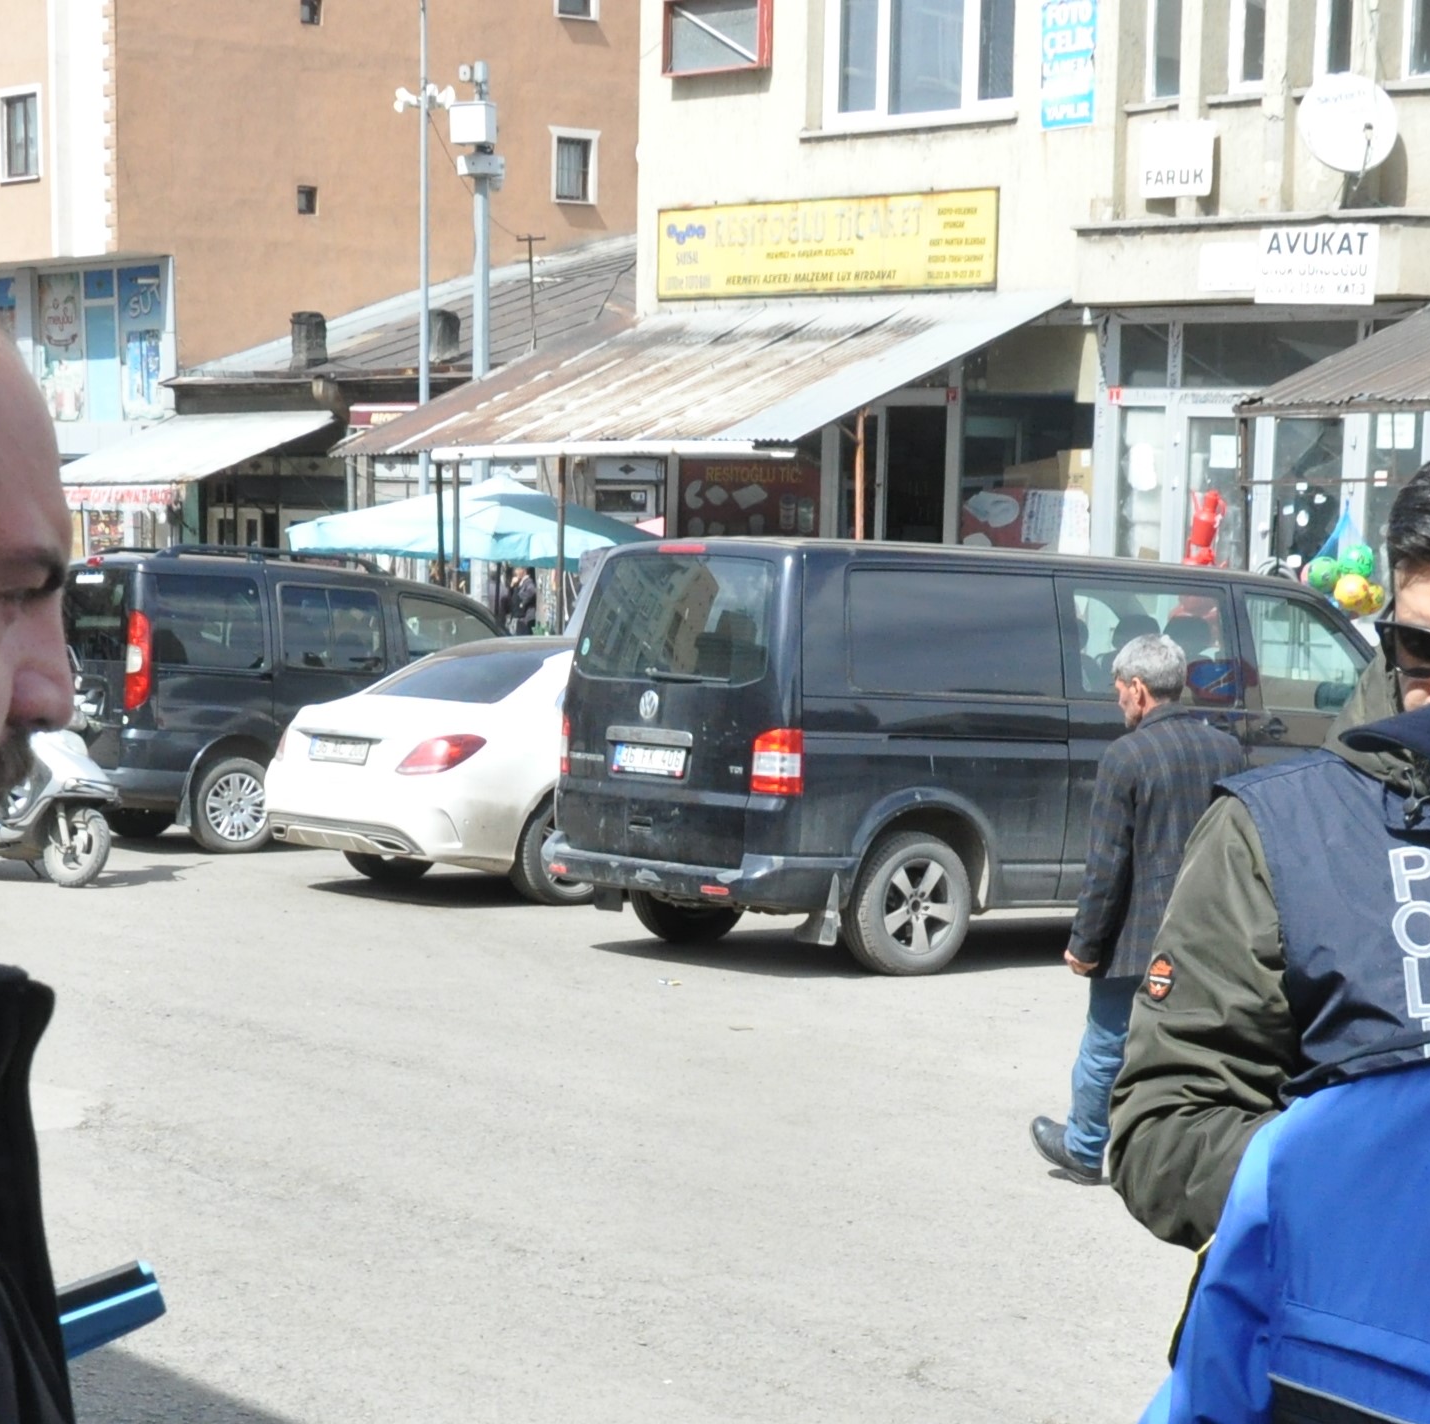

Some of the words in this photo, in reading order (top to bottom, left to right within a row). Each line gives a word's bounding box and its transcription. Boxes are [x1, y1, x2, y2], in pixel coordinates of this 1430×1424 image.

[1145, 168, 1204, 186] FARUK
[1266, 231, 1369, 256] AVUKAT
[621, 745, 635, 763] 36
